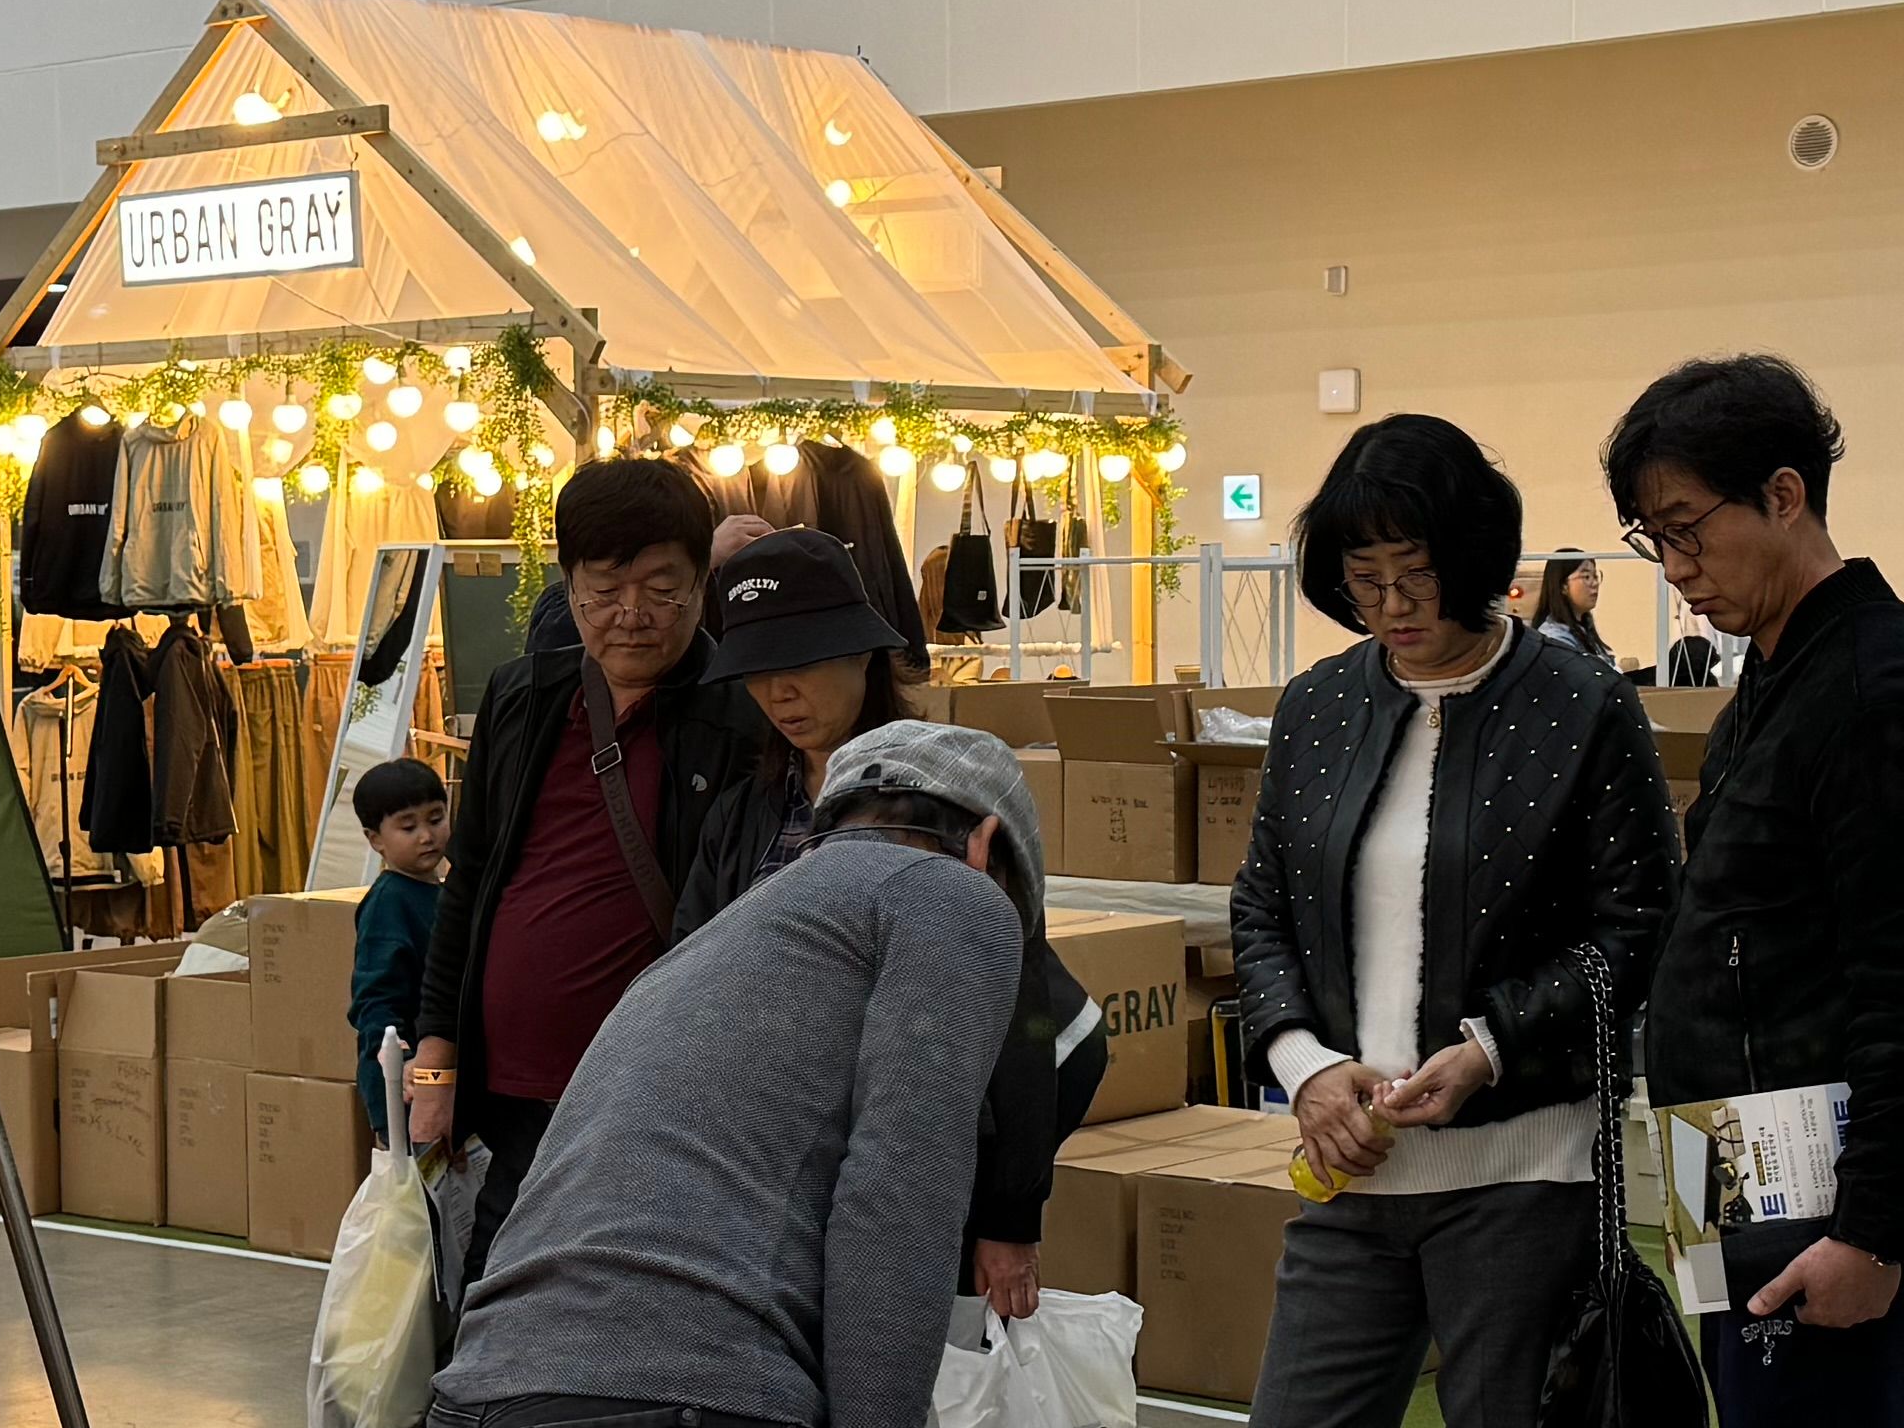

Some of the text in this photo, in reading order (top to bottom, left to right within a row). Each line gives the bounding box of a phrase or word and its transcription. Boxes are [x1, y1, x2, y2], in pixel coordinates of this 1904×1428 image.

[128, 190, 344, 268] URBAN GRAY
[728, 577, 780, 602] BROOKLYN
[1103, 982, 1178, 1037] GRAY
